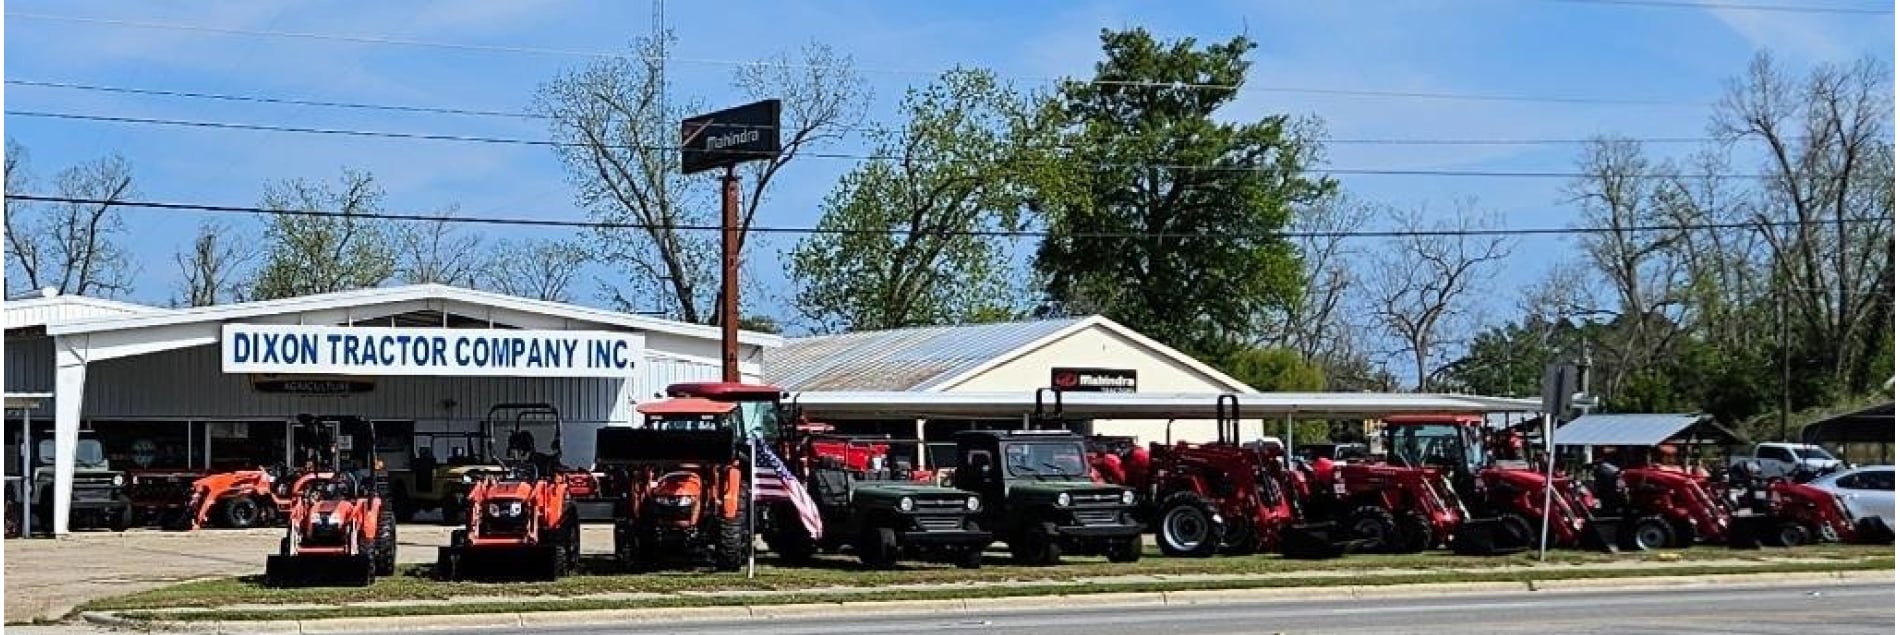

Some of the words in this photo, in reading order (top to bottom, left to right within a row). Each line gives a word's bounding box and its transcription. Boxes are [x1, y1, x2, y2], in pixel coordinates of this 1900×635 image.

[707, 127, 759, 152] Mahindra
[233, 332, 318, 363] DIXON
[327, 335, 447, 366] TRACTOR
[455, 336, 578, 368] COMPANY
[587, 339, 635, 369] INC.
